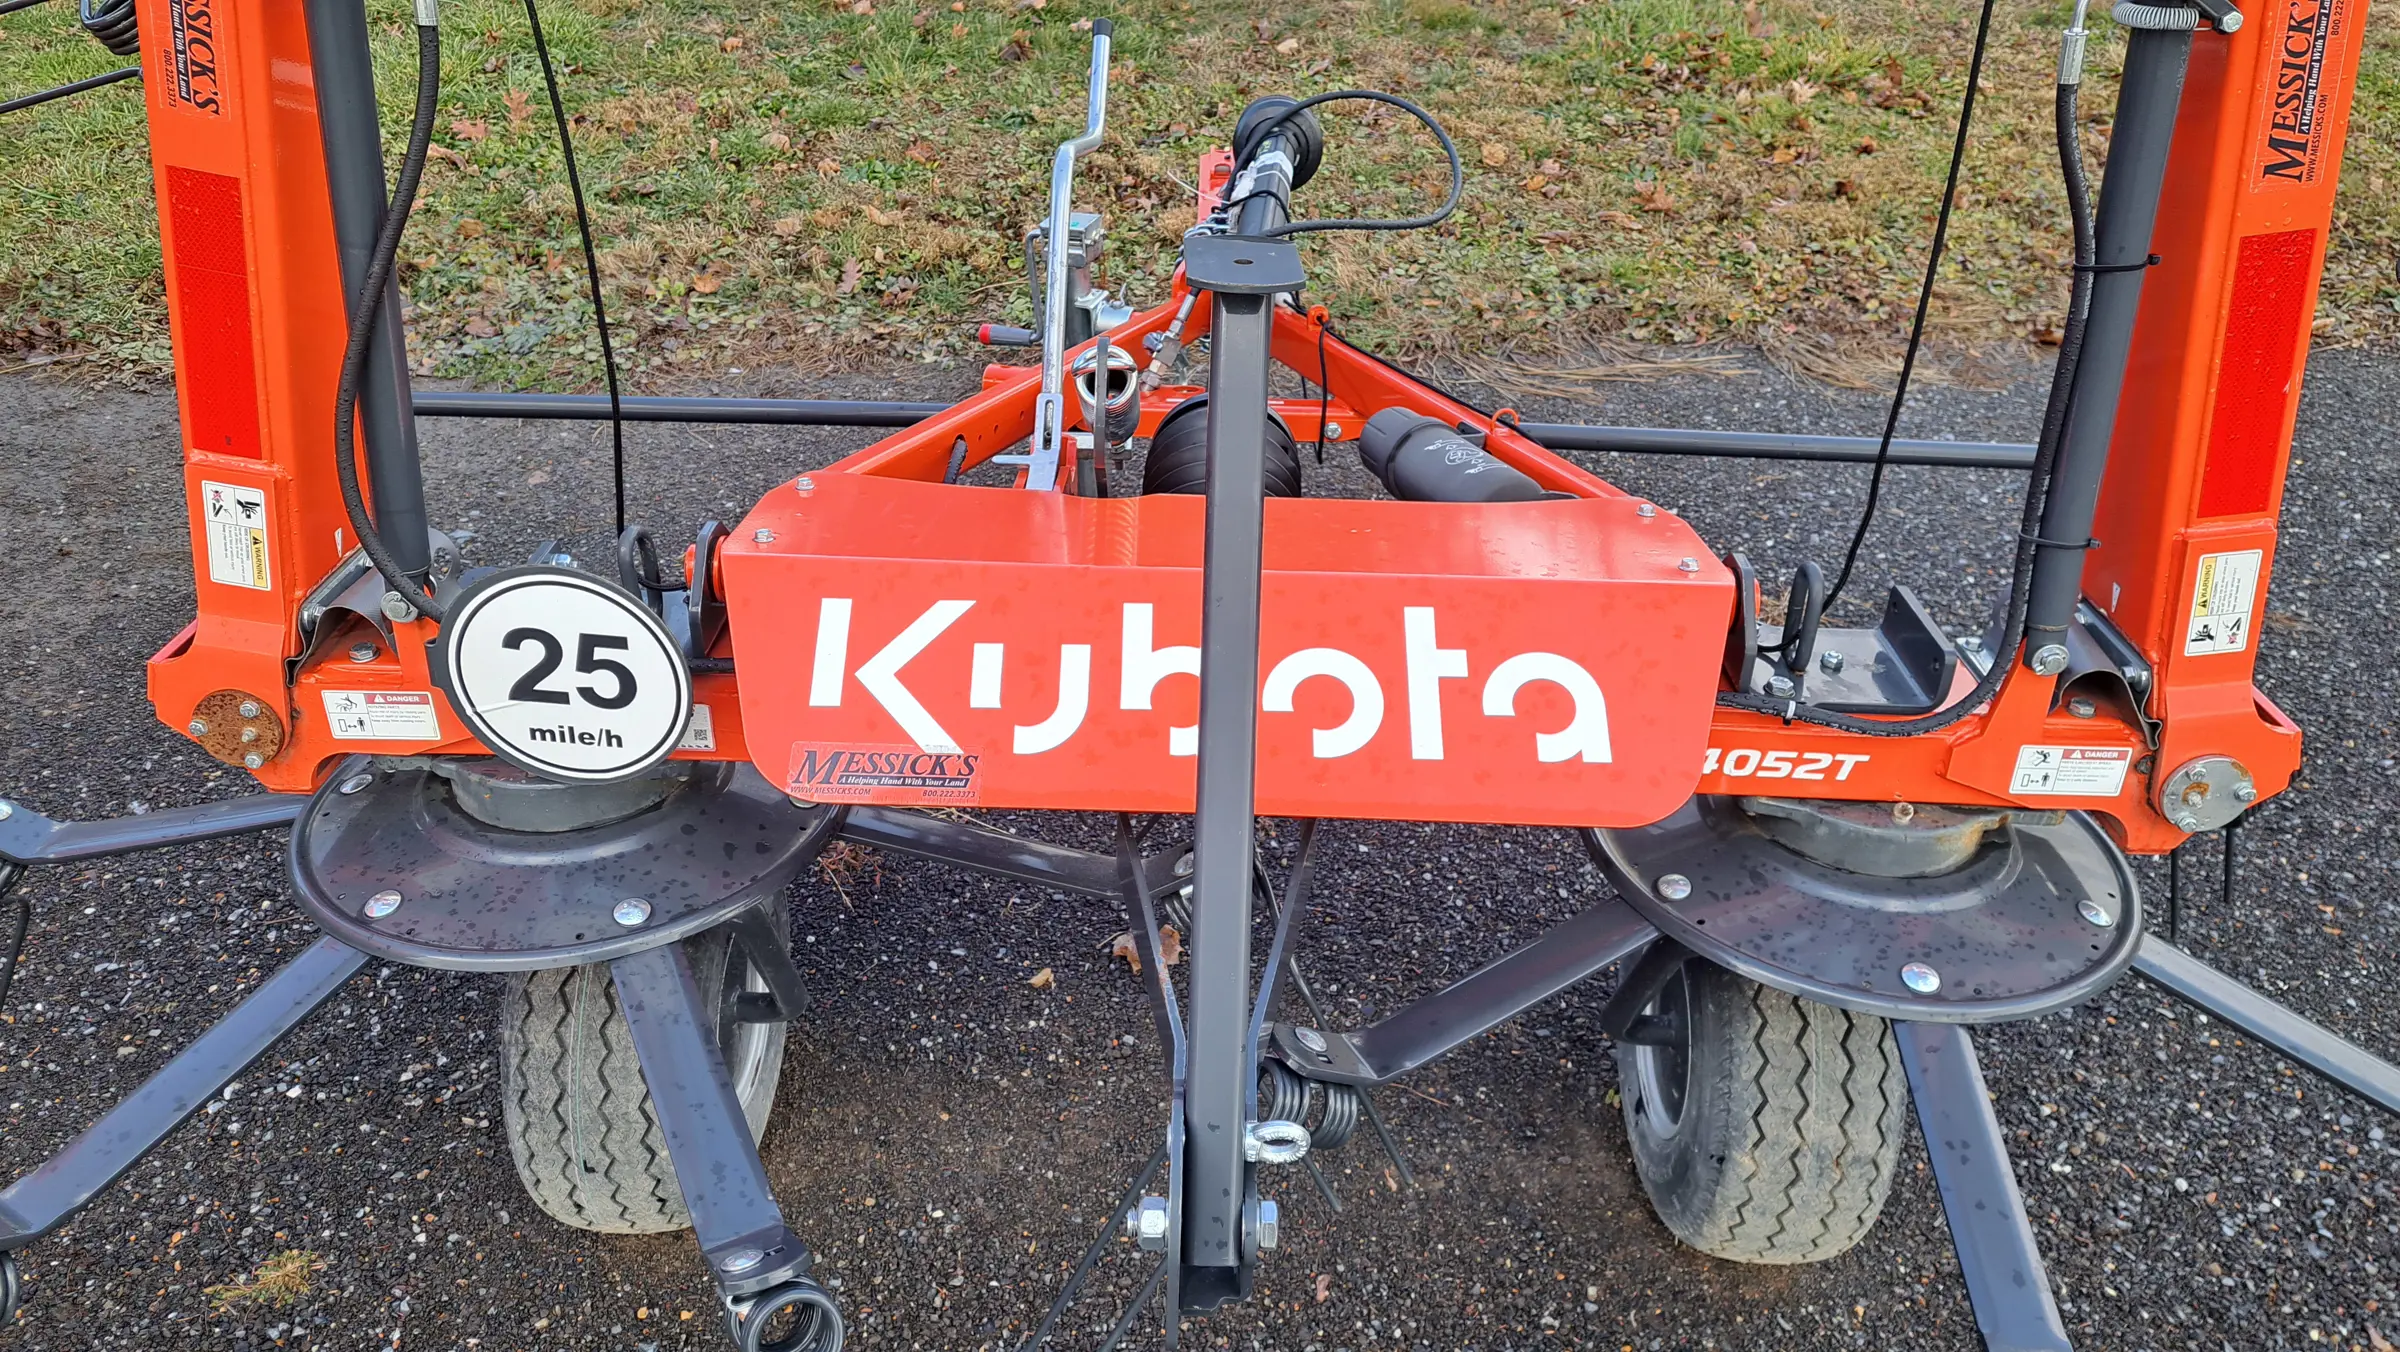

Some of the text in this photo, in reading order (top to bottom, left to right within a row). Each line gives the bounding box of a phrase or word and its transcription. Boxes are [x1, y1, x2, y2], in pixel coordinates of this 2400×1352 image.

[2316, 16, 2328, 38] Your
[171, 2, 190, 99] Hand With Your Land
[2312, 39, 2324, 60] With
[163, 48, 178, 108] 800.222.3373
[2308, 62, 2320, 87] Hand
[2262, 0, 2317, 183] MESSICK'
[2302, 89, 2317, 122] Helping
[2300, 124, 2309, 133] A
[2305, 94, 2329, 182] WWW.MESSICKS.COM
[254, 547, 264, 581] WARNING
[2200, 564, 2213, 599] WARNING
[501, 626, 638, 710] 25
[808, 597, 1613, 764] Kubota
[386, 695, 420, 703] DANGER
[529, 725, 624, 749] mile/h
[792, 749, 980, 785] MESSICK'S
[2084, 750, 2119, 759] DANGER
[838, 776, 966, 787] A Helping Hand With Your Land
[922, 789, 976, 798] 800.222.3373
